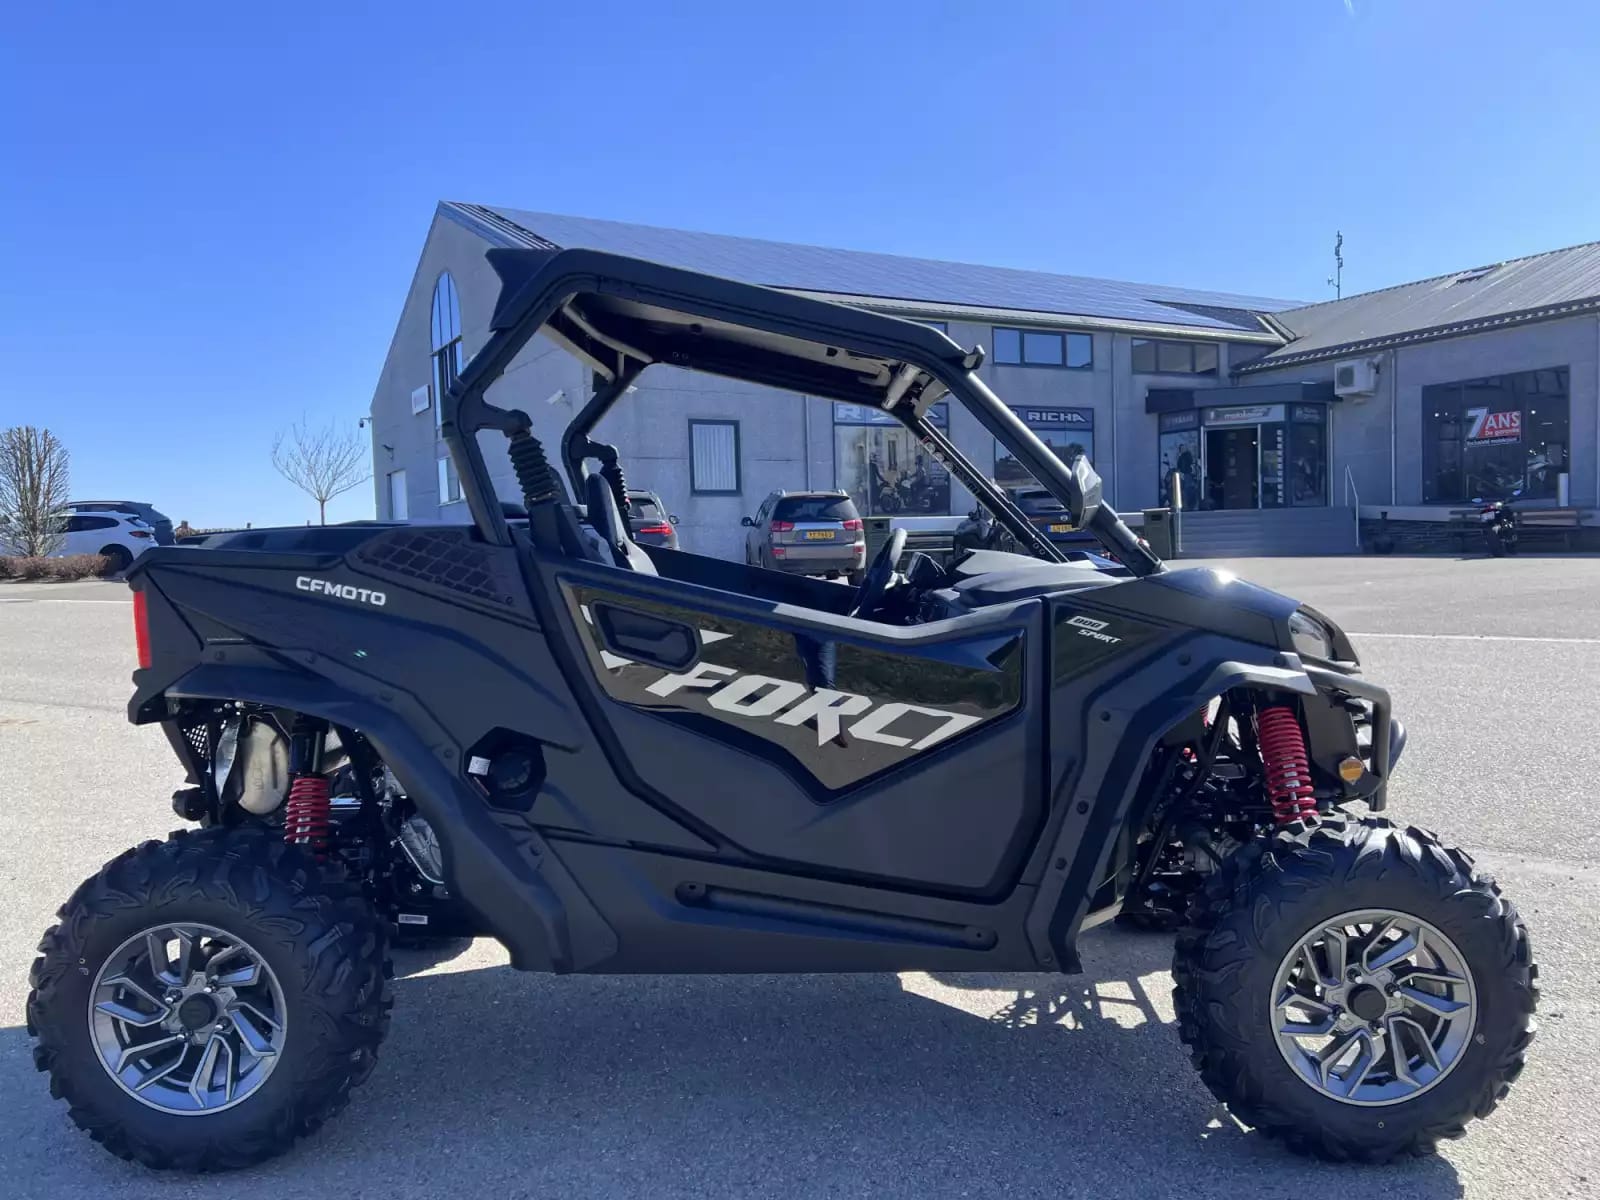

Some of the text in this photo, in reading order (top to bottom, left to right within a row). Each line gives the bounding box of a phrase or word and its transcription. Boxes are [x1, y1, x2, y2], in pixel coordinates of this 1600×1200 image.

[1028, 411, 1086, 423] RICHA
[1467, 408, 1520, 438] 7 ANS
[295, 576, 387, 607] CFMOTO
[1078, 629, 1122, 644] SPORT
